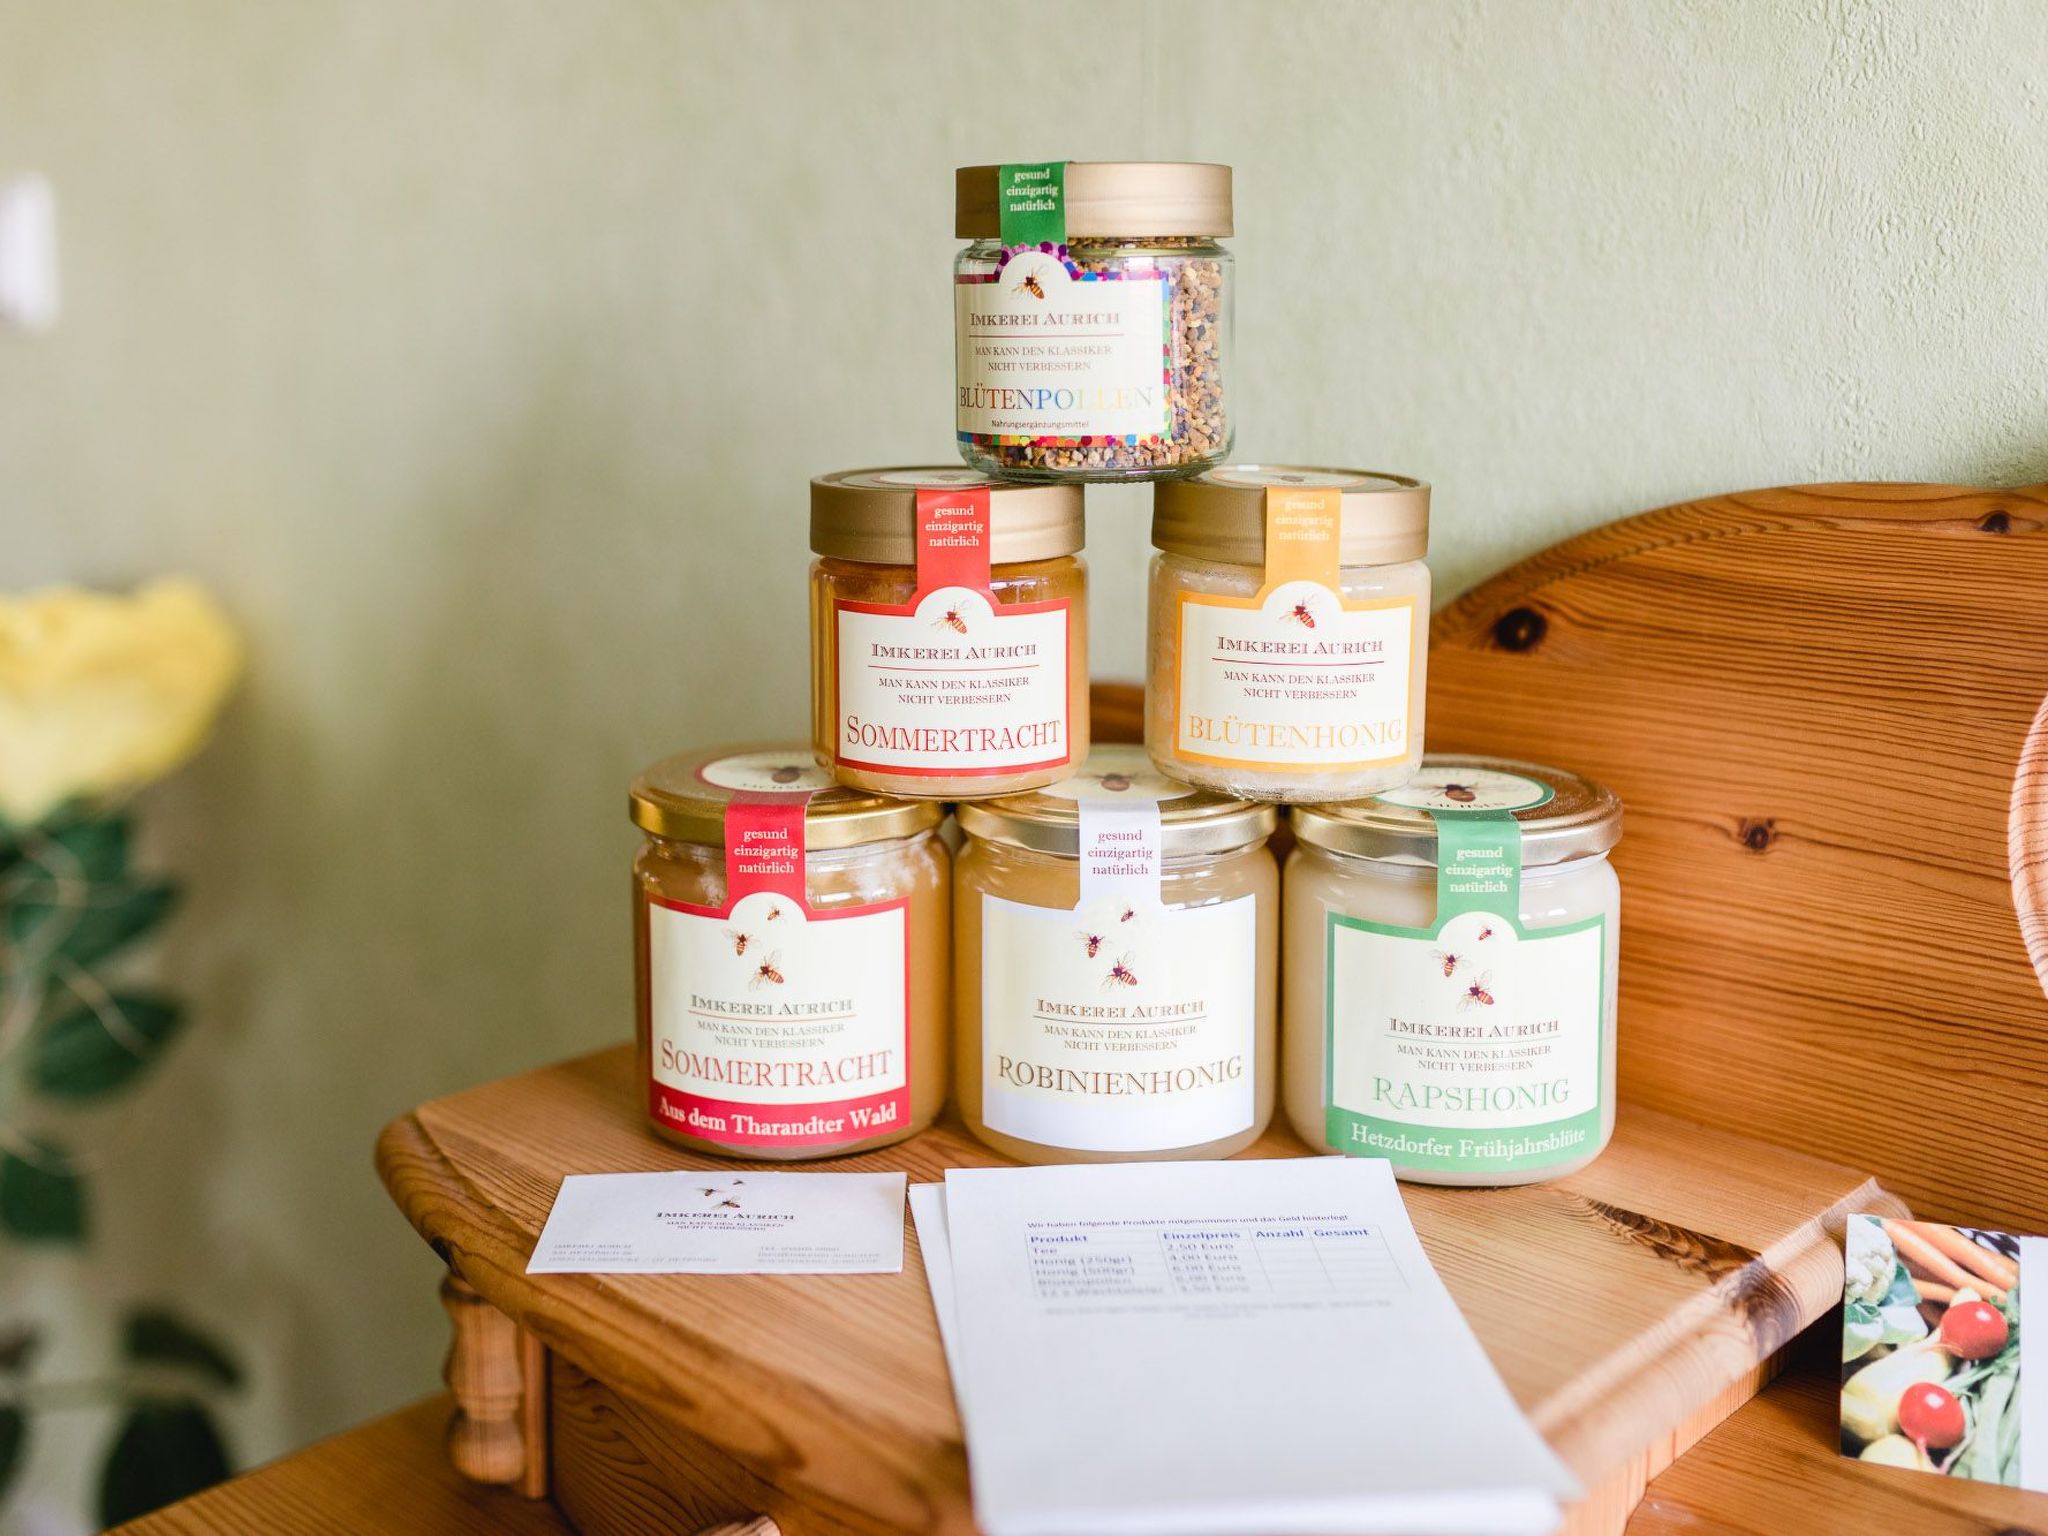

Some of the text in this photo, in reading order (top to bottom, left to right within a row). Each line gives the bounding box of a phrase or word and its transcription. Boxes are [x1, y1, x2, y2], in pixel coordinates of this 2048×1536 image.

[1014, 169, 1050, 183] gesund
[1006, 185, 1058, 199] einzigartig
[1010, 198, 1055, 211] natürlich
[970, 312, 1119, 326] IMKEREI AURICH
[975, 345, 1112, 356] MAN KANN DEN KLASSIKER
[988, 361, 1091, 372] NICHT VERBESSERN
[959, 382, 1153, 410] BLÜTENPOLLEN
[991, 419, 1089, 430] Nahrungsergänzungsmittel
[934, 505, 974, 517] gesund
[925, 521, 984, 534] einzigartig
[929, 536, 979, 547] natürlich
[871, 643, 1037, 660] IMKEREI AURICH
[1217, 636, 1383, 655] IMKEREI AURICH
[879, 677, 1029, 690] MAN KANN DEN KLASSIKER
[1224, 671, 1375, 684] MAN KANN DEN KLASSIKER
[898, 693, 1011, 705] NICHT VERBESSERN
[1243, 687, 1357, 700] NICHT VERBESSERN
[847, 715, 1061, 752] SOMMERTRACHT
[1189, 714, 1401, 748] BLÜTENHONIG
[744, 828, 788, 842] gesund
[1098, 830, 1142, 843] gesund
[734, 844, 798, 860] einzigartig
[1088, 846, 1153, 861] einzigartig
[1456, 847, 1503, 861] gesund
[739, 861, 794, 874] natürlich
[1092, 863, 1148, 875] natürlich
[1445, 863, 1513, 879] einzigartig
[1449, 881, 1508, 893] natürlich
[690, 994, 853, 1016] IMKEREI AURICH
[1036, 999, 1206, 1018] IMKEREI AURICH
[698, 1020, 845, 1036] MAN KANN DEN KLASSIKER
[1044, 1024, 1197, 1039] MAN KANN DEN KLASSIKER
[1389, 1017, 1559, 1038] IMKEREI AURICH
[715, 1035, 825, 1049] NICHT VERBESSERN
[1064, 1040, 1178, 1052] NICHT VERBESSERN
[1397, 1044, 1552, 1059] MAN KANN DEN KLASSIKER
[661, 1039, 894, 1087] SOMMERTRACHT
[1418, 1059, 1534, 1072] NICHT VERBESSERN
[999, 1055, 1243, 1095] ROBINIENHONIG
[1372, 1076, 1570, 1113] RAPSHONIG
[658, 1097, 898, 1137] Aus dem Tharandter Wald
[1351, 1121, 1586, 1161] Hetzdorfer Frühjahrsblüte
[1030, 1228, 1371, 1243] Produkt Einzelpreis Anzahl Gesamt
